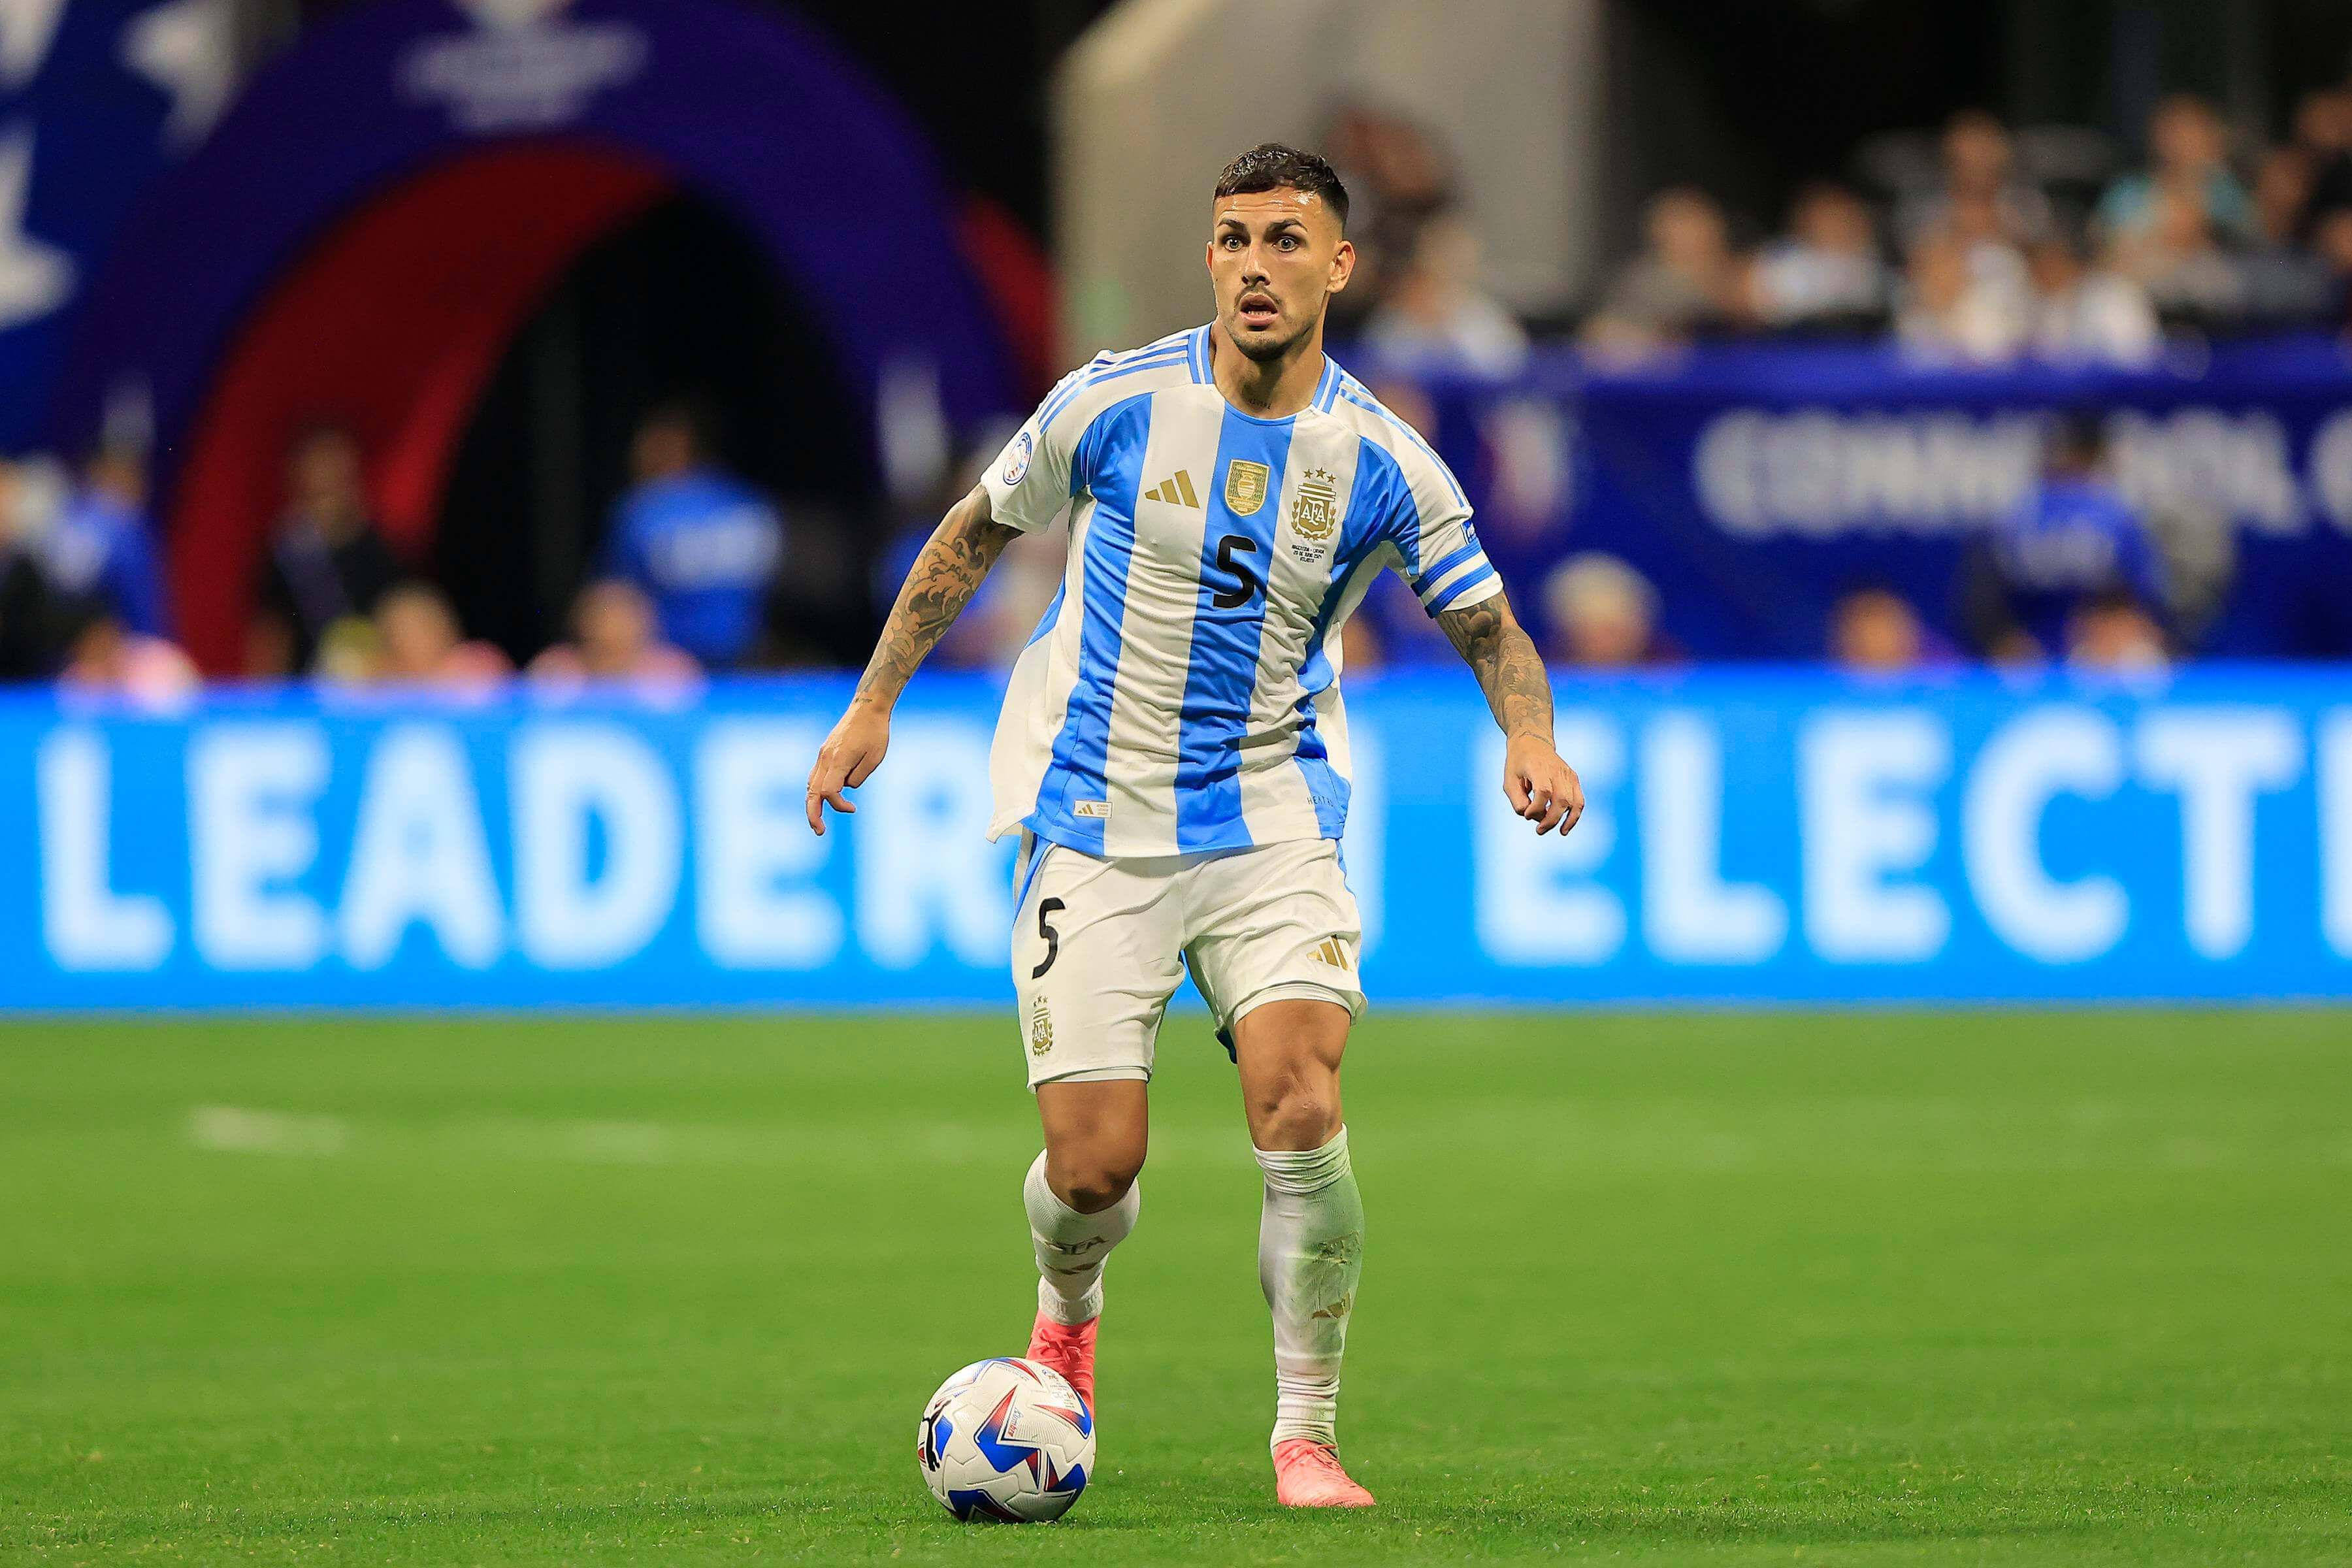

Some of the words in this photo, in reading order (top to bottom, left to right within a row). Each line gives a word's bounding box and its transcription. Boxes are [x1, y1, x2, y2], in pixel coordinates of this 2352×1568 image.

[1300, 498, 1326, 525] AFA
[1213, 534, 1257, 609] 5
[39, 721, 1017, 967] LEADER
[1475, 711, 2352, 959] ELECT
[1032, 897, 1066, 979] 5
